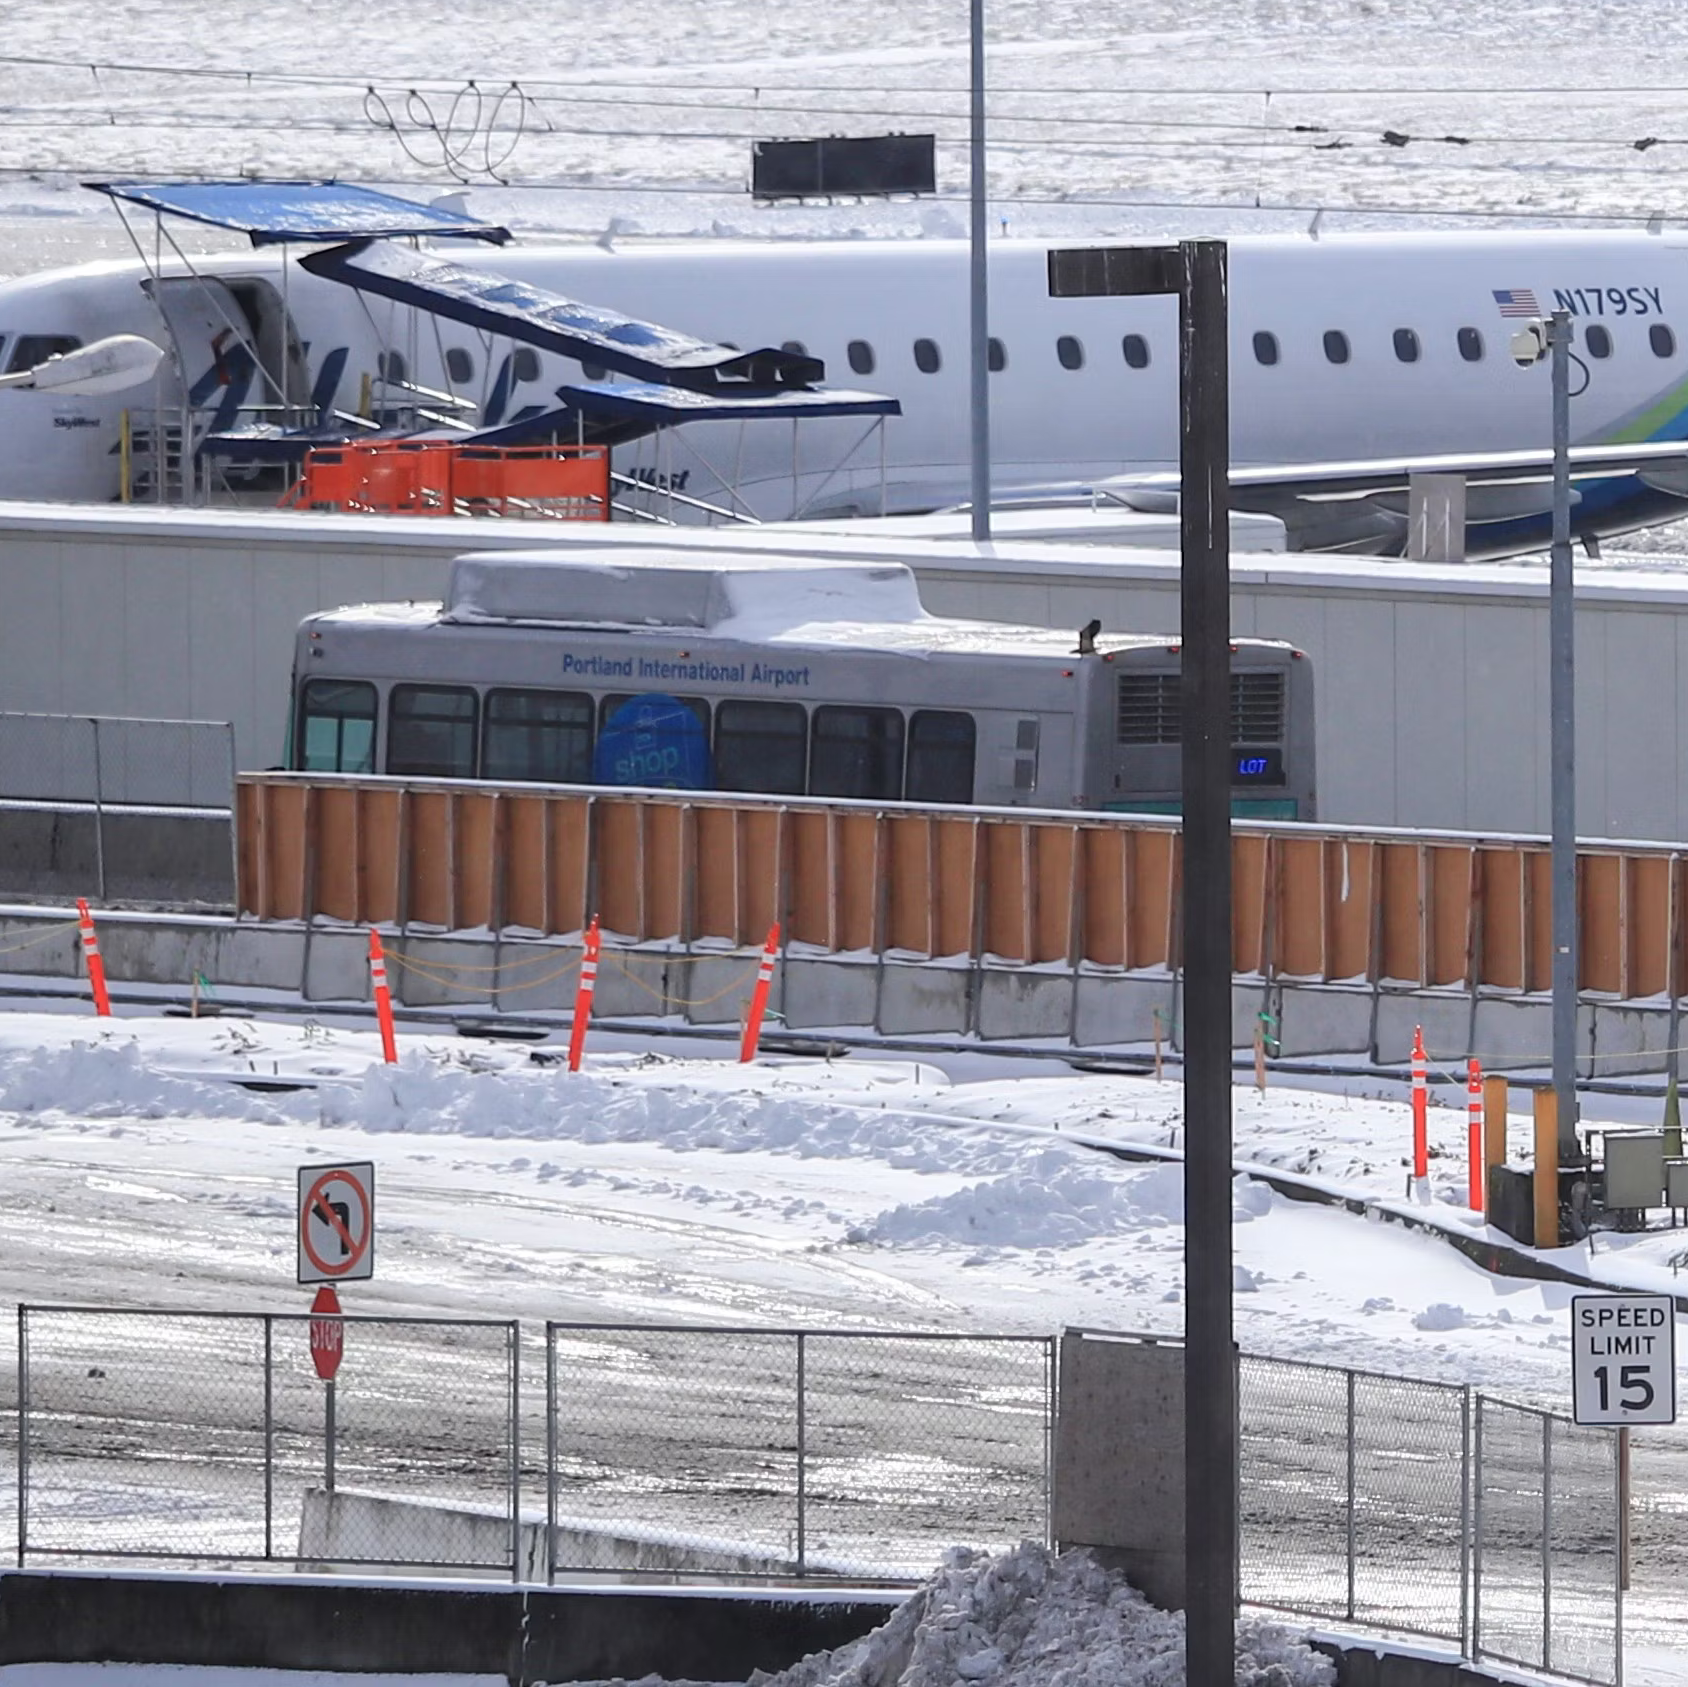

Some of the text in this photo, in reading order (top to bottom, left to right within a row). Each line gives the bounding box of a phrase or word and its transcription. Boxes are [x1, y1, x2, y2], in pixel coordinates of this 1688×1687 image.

[1552, 287, 1664, 316] N179SY
[562, 653, 811, 688] Portland International Airport
[615, 744, 678, 784] shop
[1238, 758, 1268, 775] LOT
[1581, 1307, 1665, 1328] SPEED
[311, 1319, 342, 1352] STOP
[1590, 1335, 1656, 1356] LIMIT
[1593, 1364, 1655, 1411] 15
